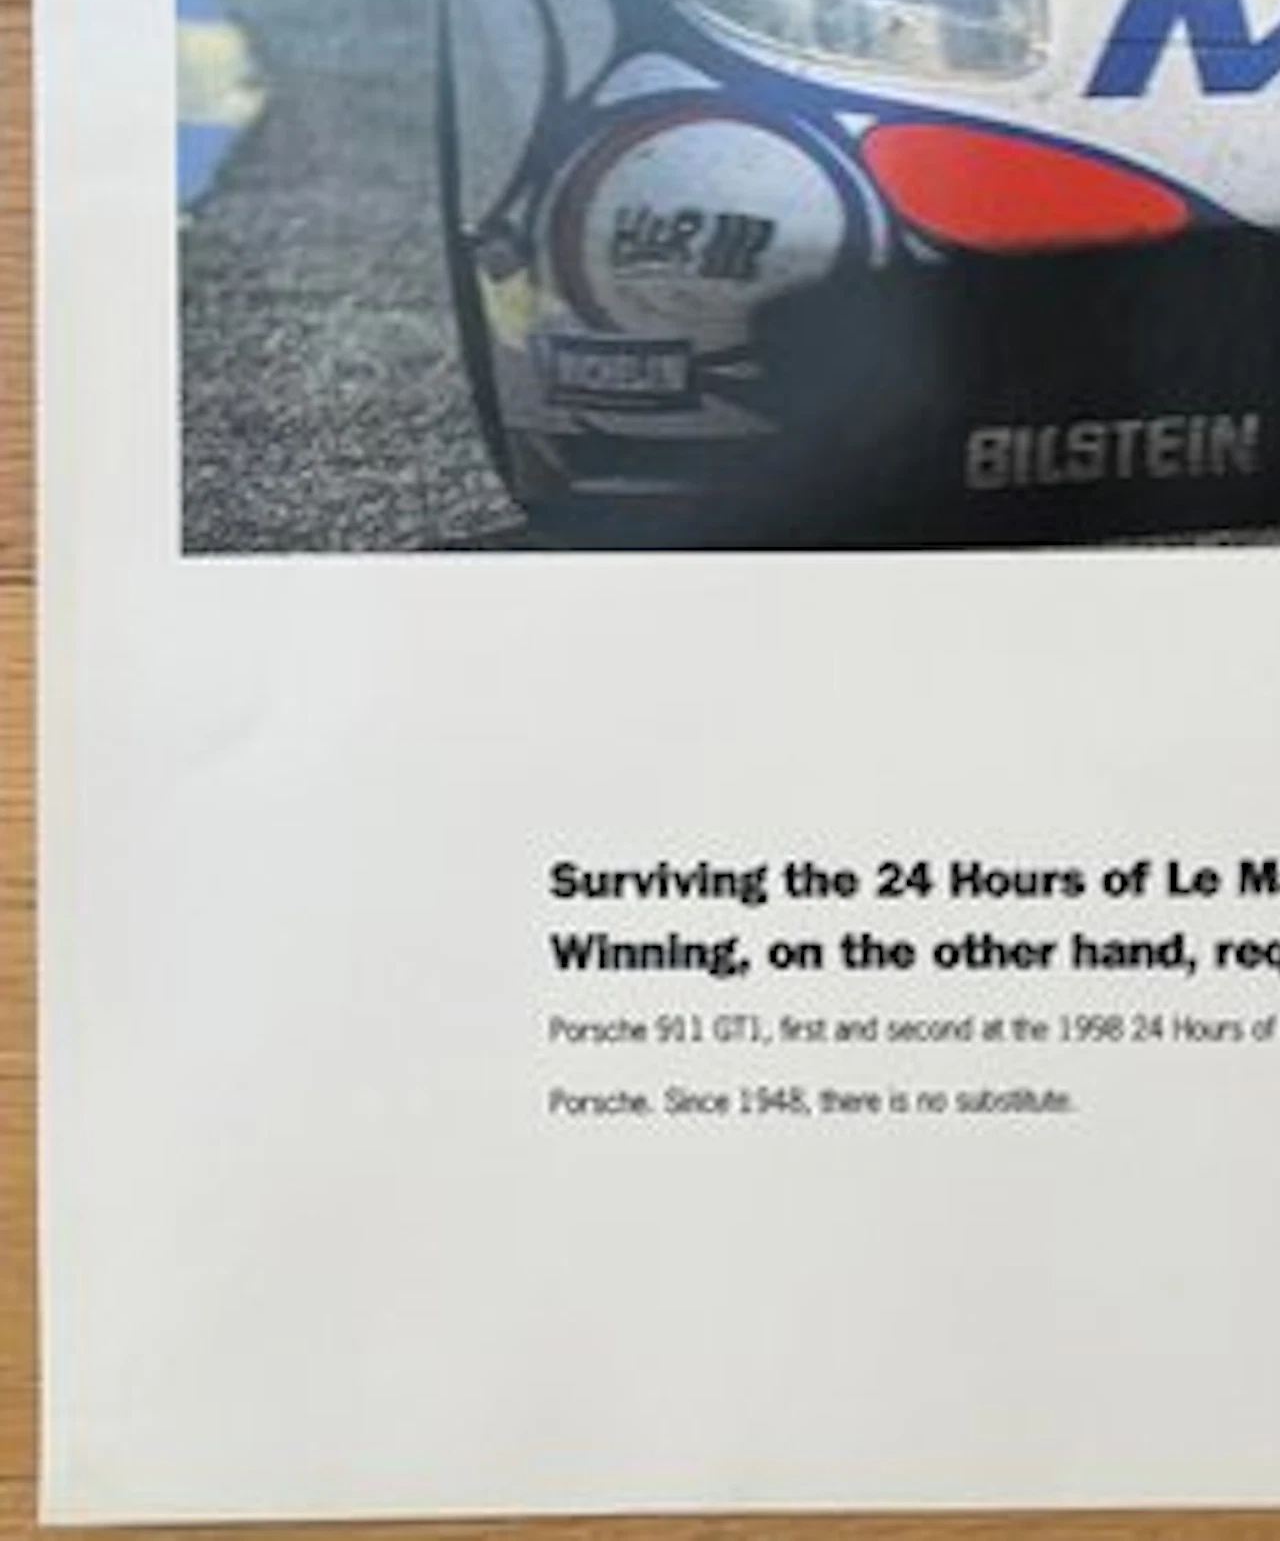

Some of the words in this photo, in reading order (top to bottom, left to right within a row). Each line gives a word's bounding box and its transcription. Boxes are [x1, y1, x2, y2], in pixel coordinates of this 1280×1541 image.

[965, 412, 1260, 491] BILSTEIN
[549, 861, 768, 907] Surviving
[782, 861, 860, 897] the
[876, 861, 935, 897] 24
[950, 861, 1086, 898] Hours
[1102, 859, 1152, 898] of
[1167, 860, 1221, 897] Le
[549, 933, 750, 978] Winning,
[768, 941, 823, 970] on
[840, 933, 916, 969] the
[933, 933, 1057, 969] other
[1072, 932, 1197, 977] hand,
[549, 1014, 648, 1043] Porsche
[654, 1014, 703, 1043] 911
[712, 1014, 774, 1046] GT1,
[778, 1014, 828, 1043] first
[834, 1014, 880, 1043] and
[886, 1014, 974, 1043] second
[982, 1014, 1004, 1043] at
[1010, 1014, 1050, 1043] the
[1060, 1014, 1125, 1043] 1998
[1131, 1014, 1163, 1043] 24
[1172, 1014, 1245, 1043] Hours
[1251, 1014, 1277, 1043] of
[549, 1086, 655, 1115] Porsche.
[664, 1086, 730, 1115] Since
[739, 1086, 811, 1115] 1948,
[817, 1086, 882, 1115] there
[888, 1086, 909, 1115] is
[916, 1090, 948, 1115] no
[955, 1086, 1077, 1115] substitute.
